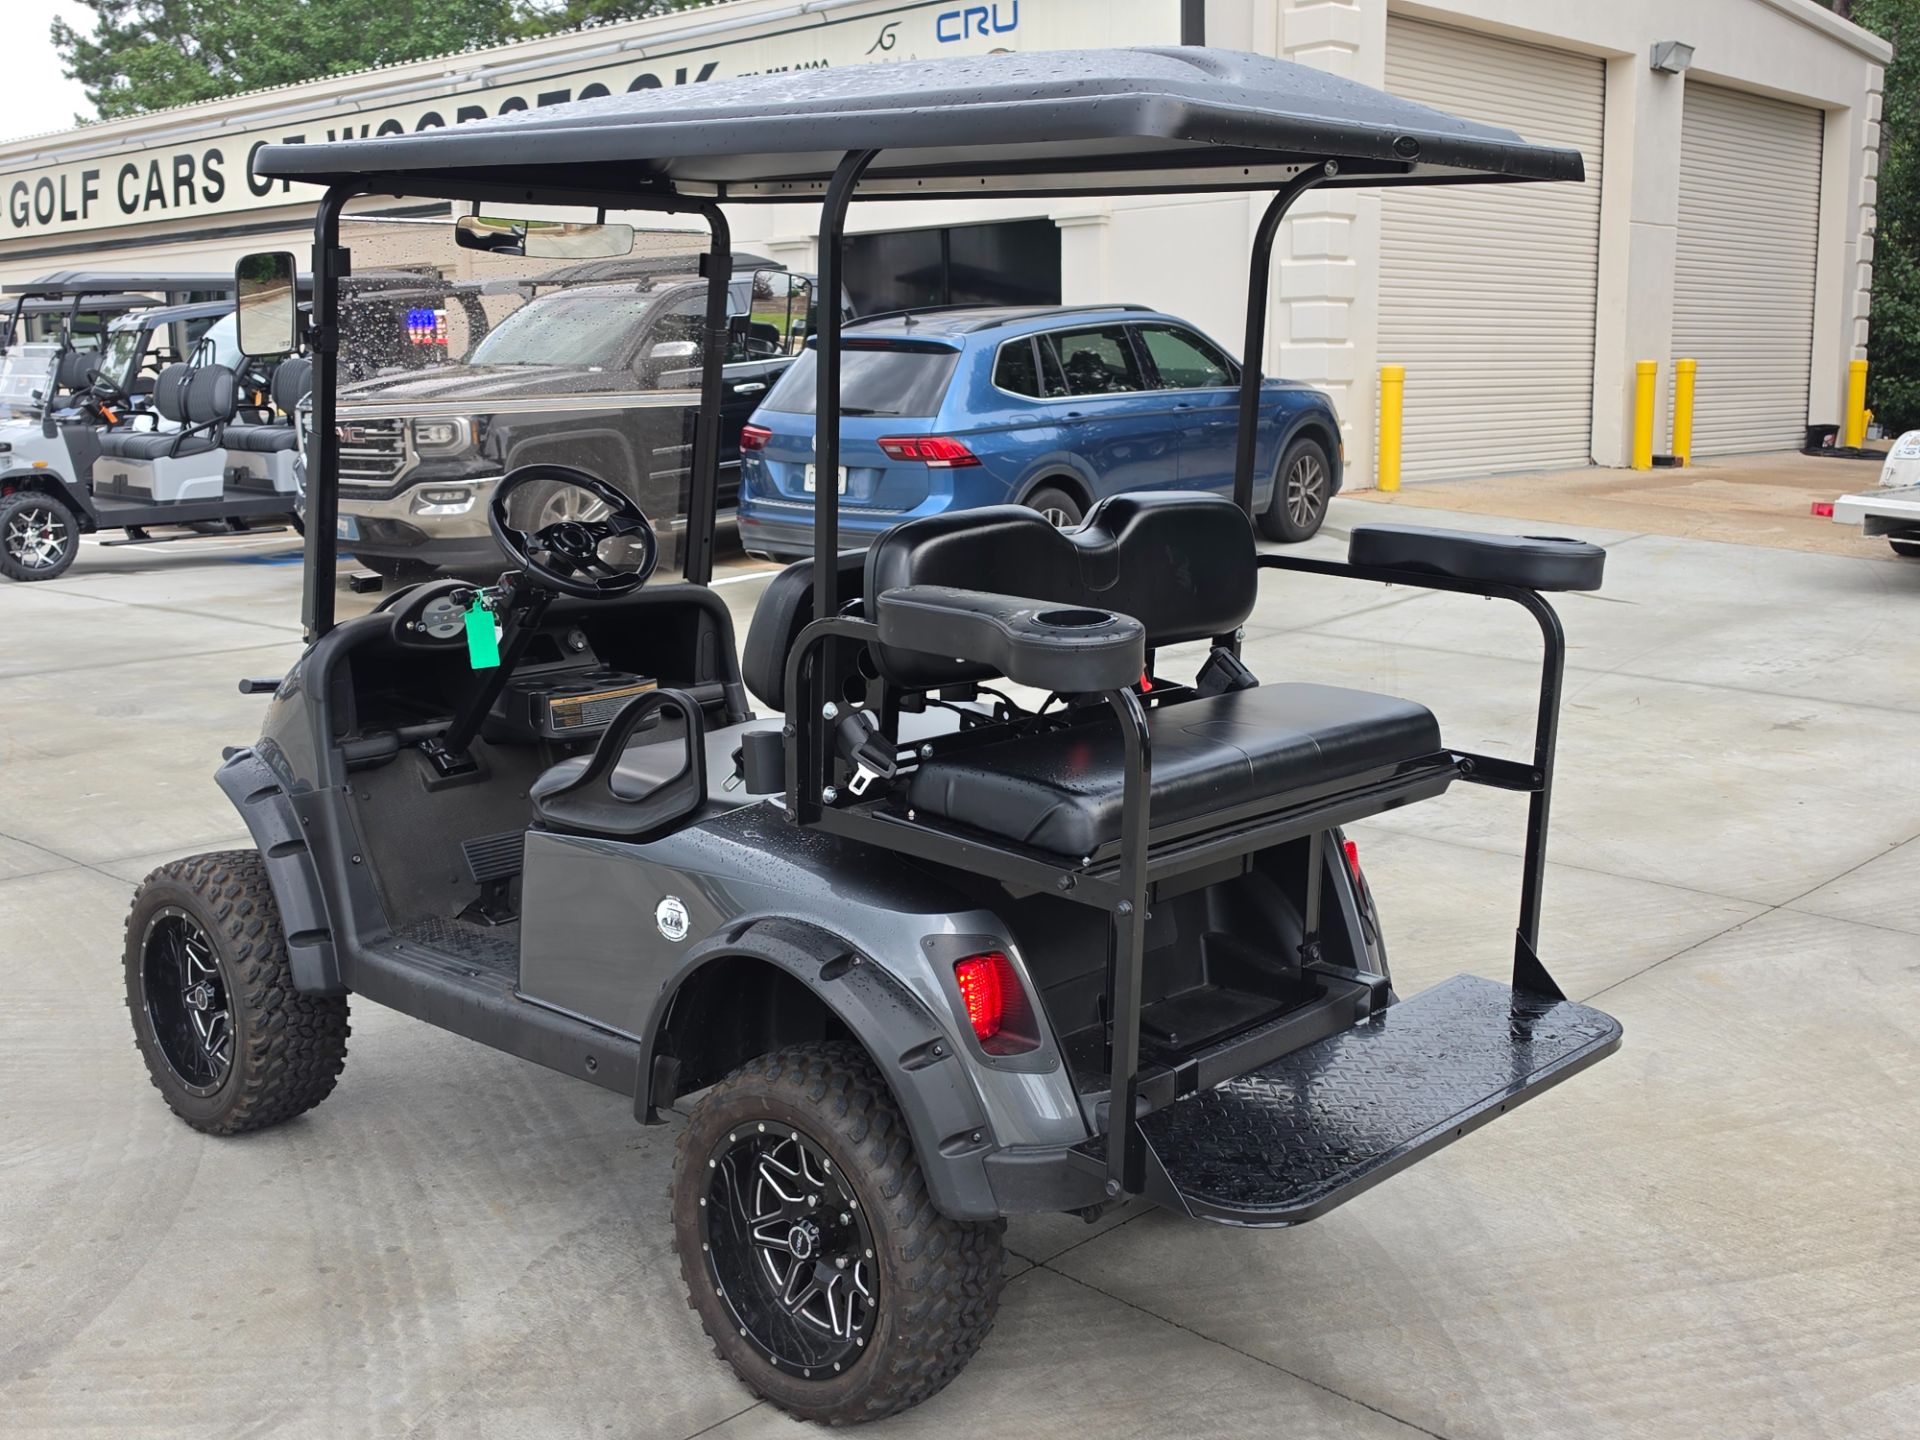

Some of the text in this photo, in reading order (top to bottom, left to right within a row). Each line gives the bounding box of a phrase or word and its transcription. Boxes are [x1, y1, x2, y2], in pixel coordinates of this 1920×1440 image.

[936, 0, 1019, 43] CRU
[9, 169, 100, 228] GOLF
[117, 148, 226, 215] CARS
[335, 426, 366, 443] MC
